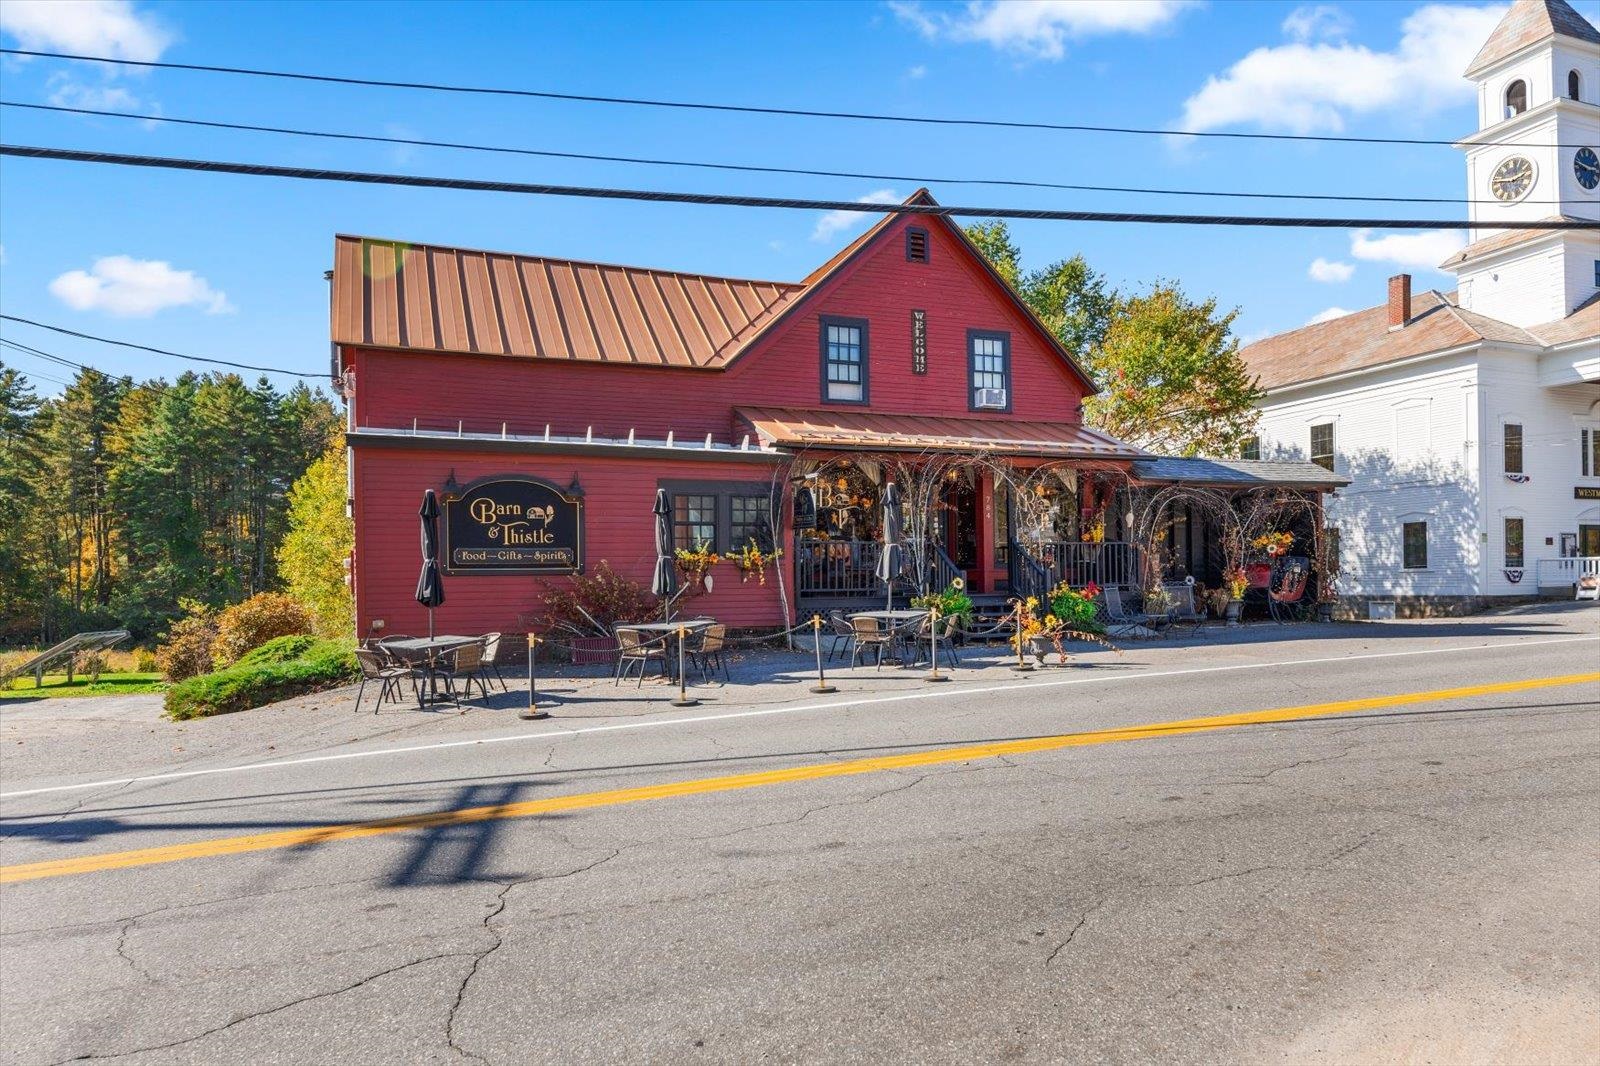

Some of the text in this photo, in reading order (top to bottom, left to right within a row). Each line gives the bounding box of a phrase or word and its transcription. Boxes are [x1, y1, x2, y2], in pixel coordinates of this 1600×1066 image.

[914, 312, 925, 372] WELCOME
[470, 497, 521, 524] Barn
[488, 521, 555, 546] & Thistle
[462, 551, 567, 562] Food Gifts Spirits
